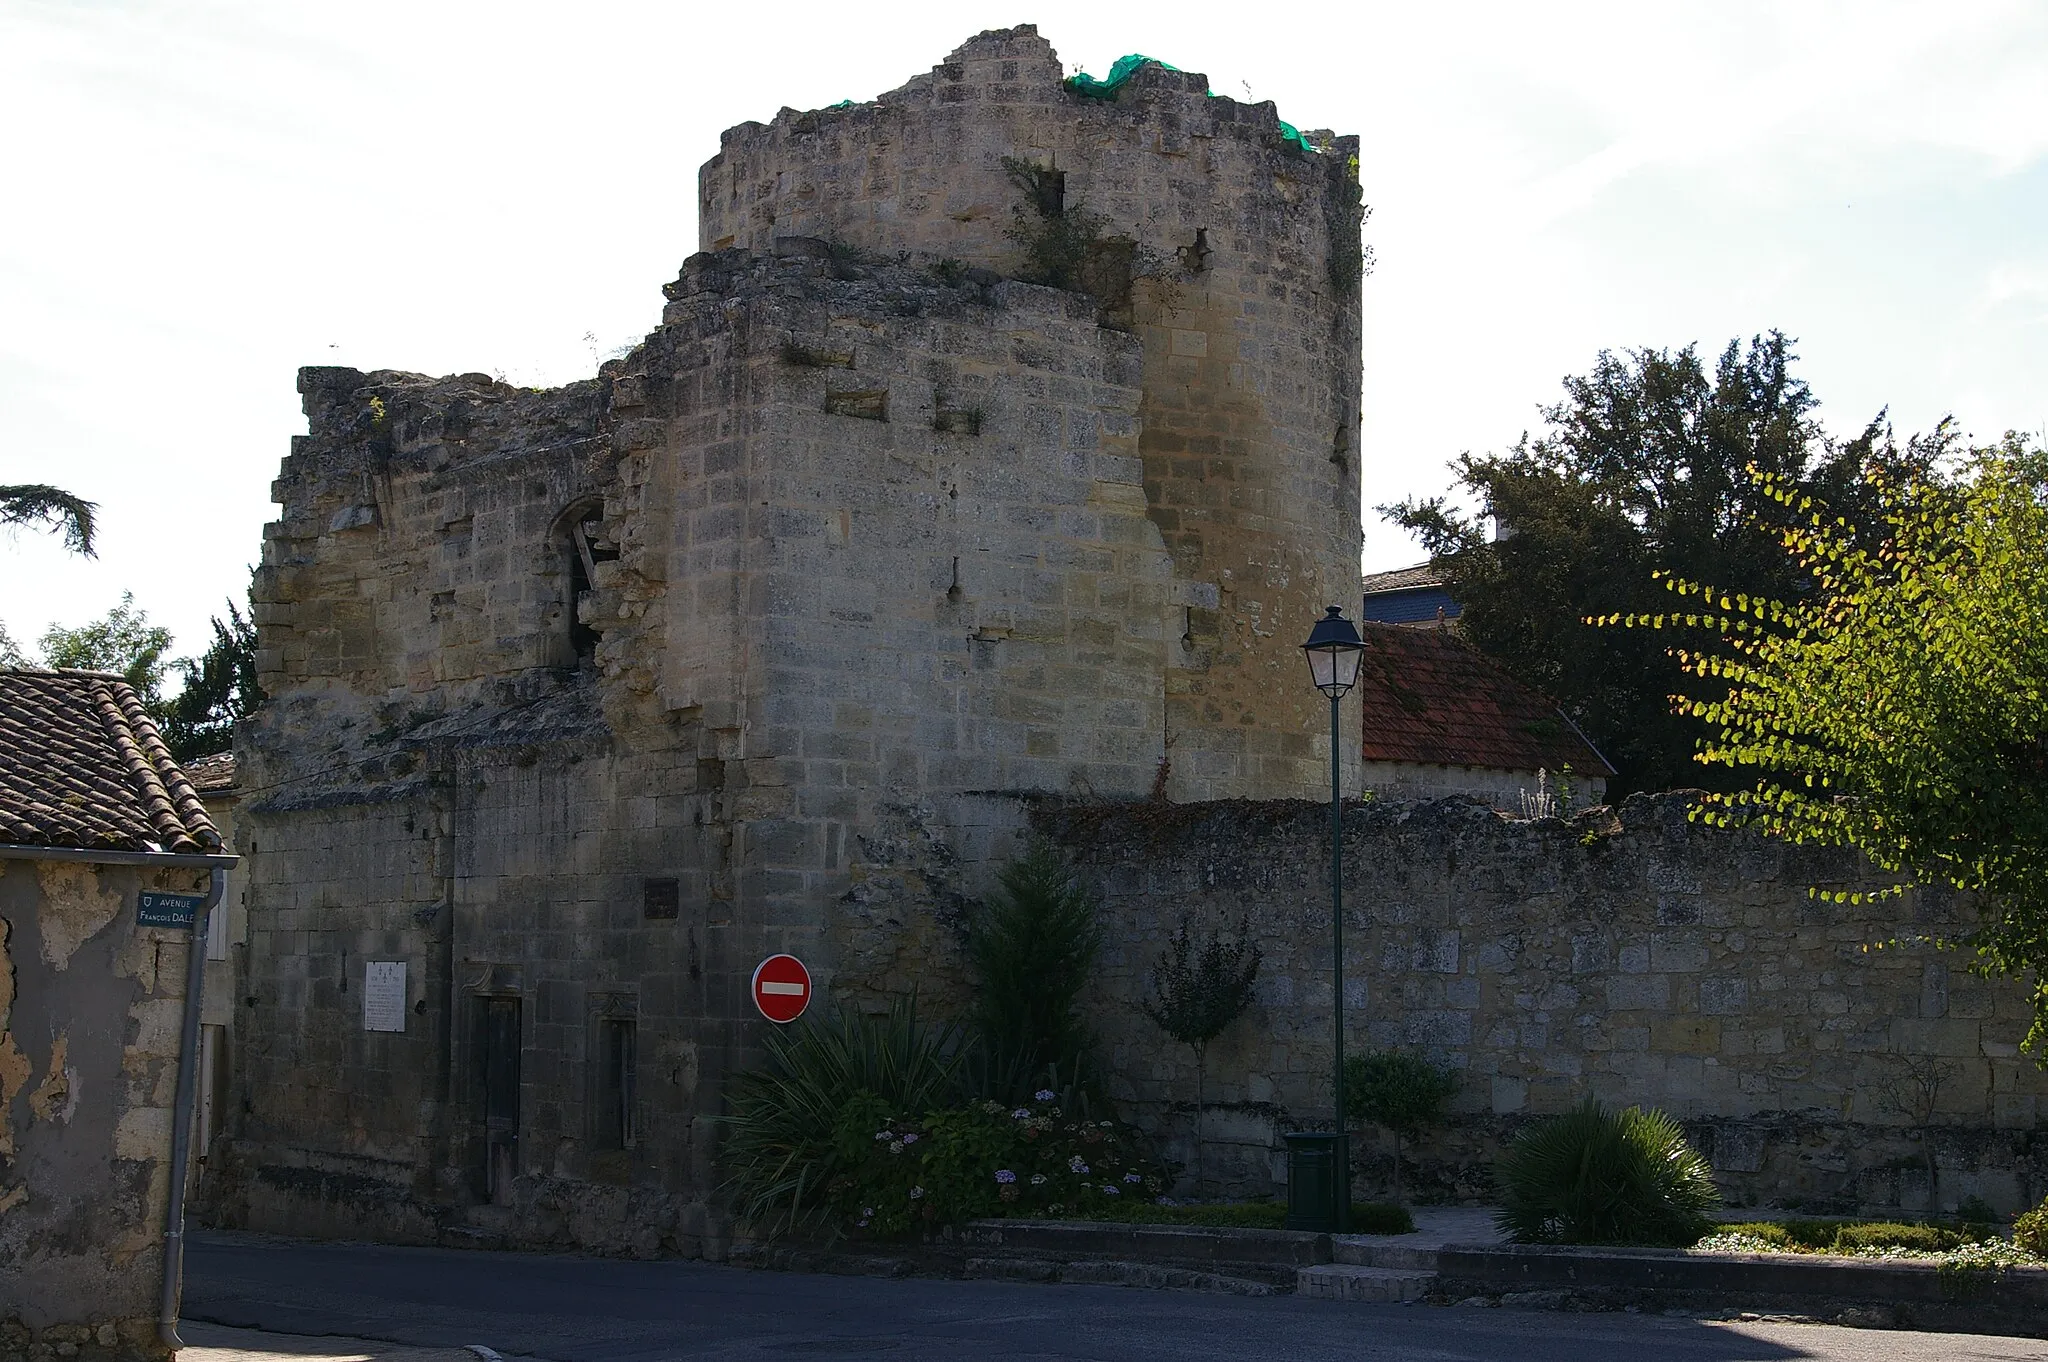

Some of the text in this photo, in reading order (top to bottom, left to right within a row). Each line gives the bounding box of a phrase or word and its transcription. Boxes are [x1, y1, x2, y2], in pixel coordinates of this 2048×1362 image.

[159, 899, 191, 909] AVENUE
[140, 911, 194, 923] FRANÇOIS DALE
